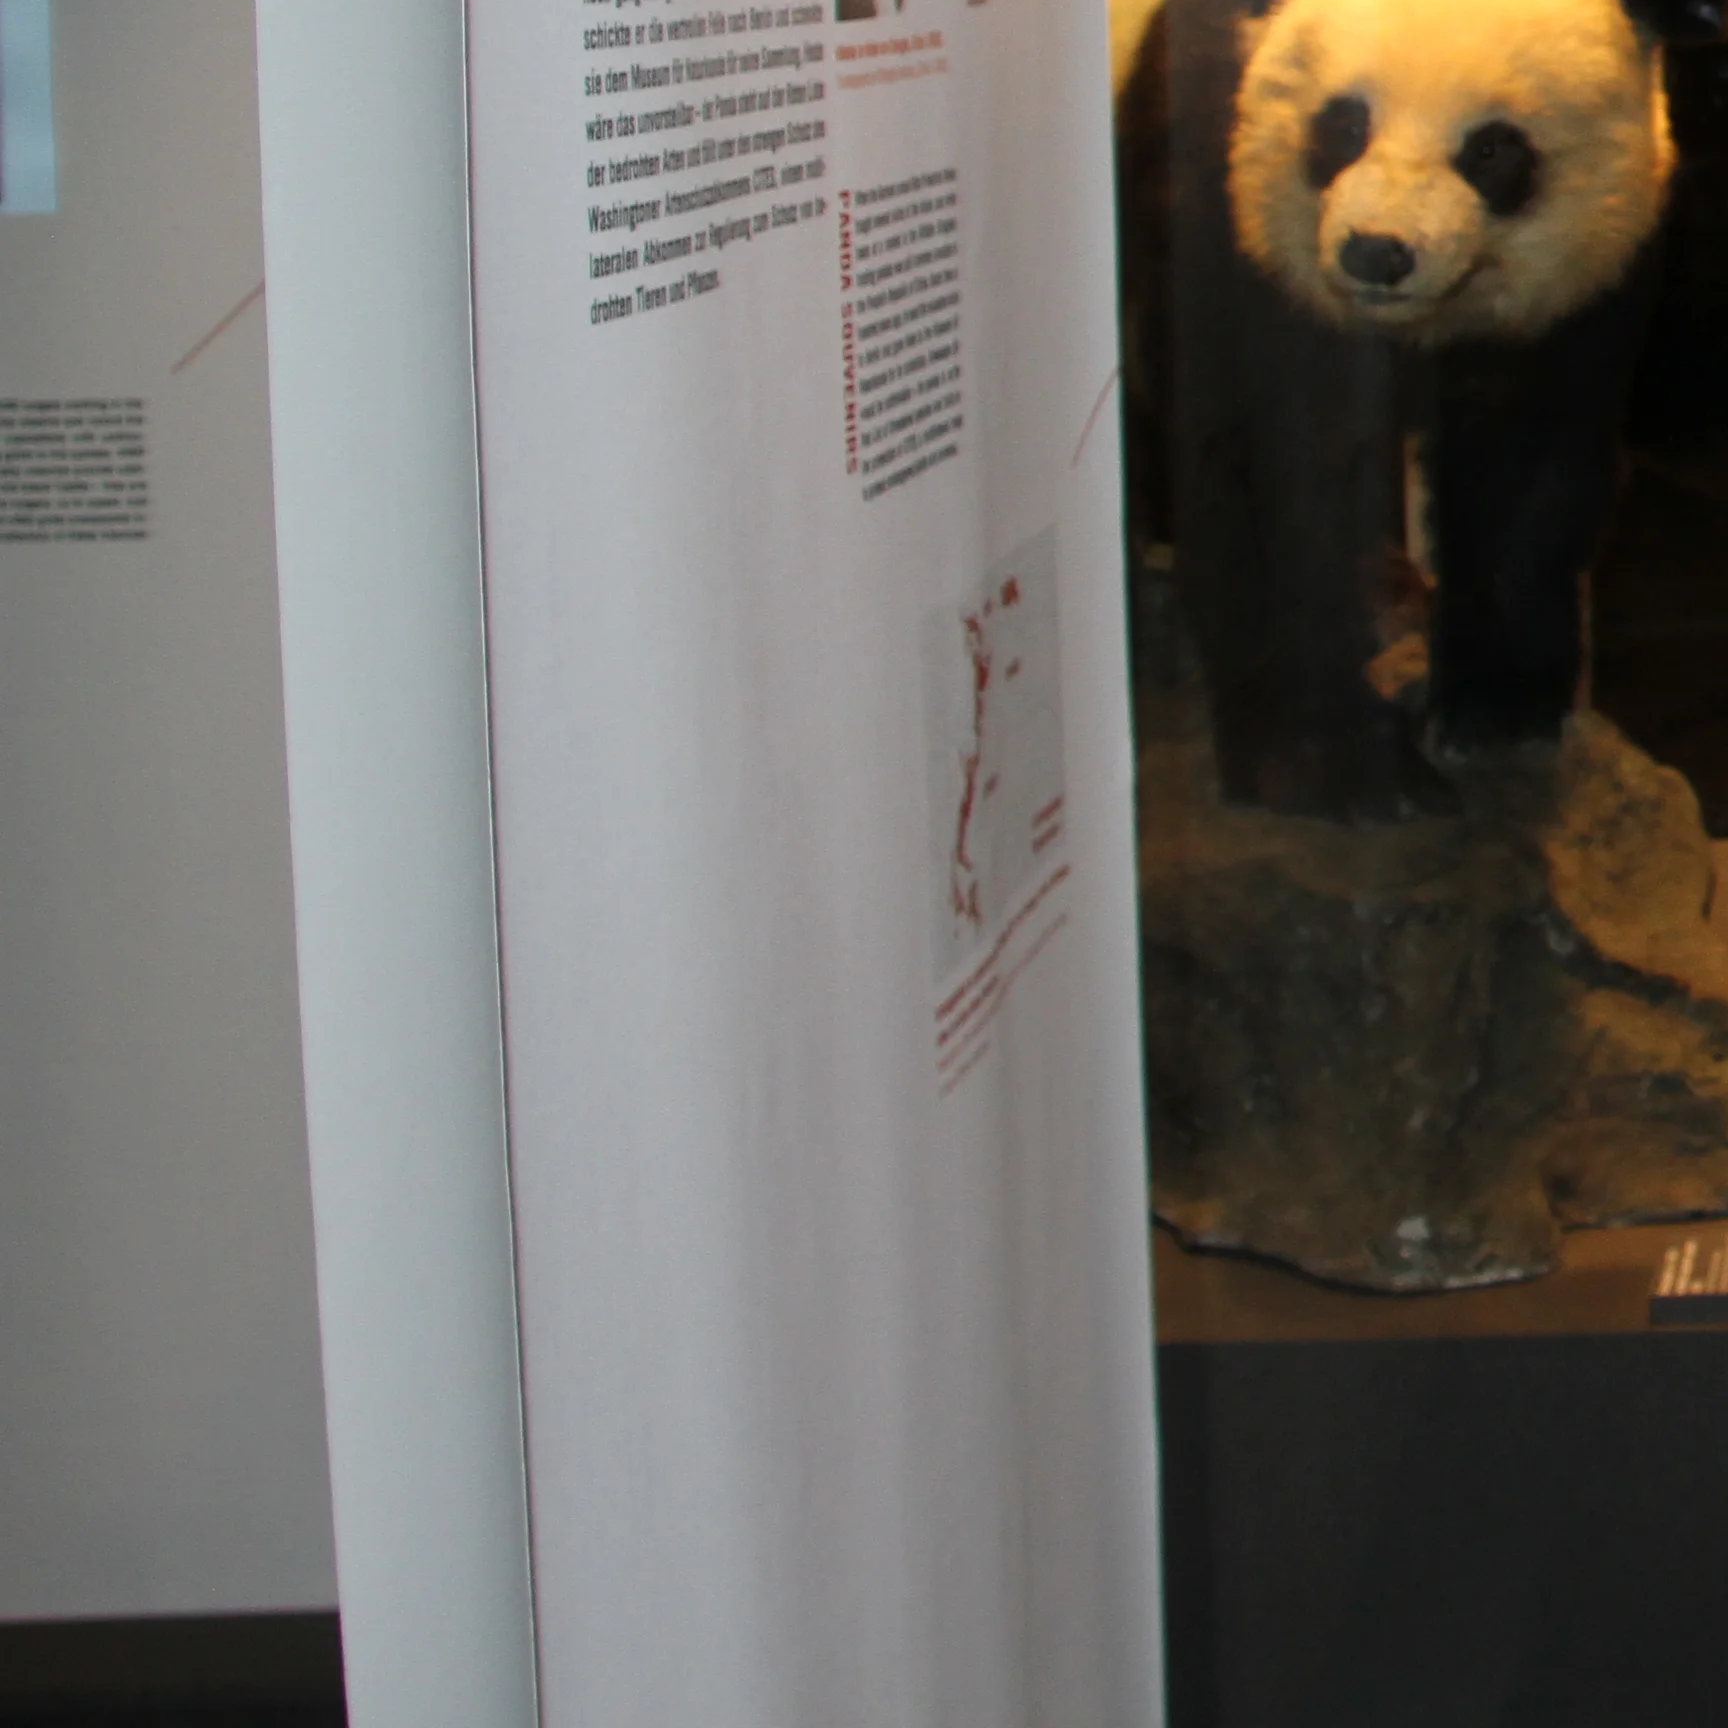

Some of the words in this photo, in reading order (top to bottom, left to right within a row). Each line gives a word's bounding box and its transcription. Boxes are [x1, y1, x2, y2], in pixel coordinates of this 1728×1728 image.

[583, 21, 631, 50] schickte
[635, 24, 646, 45] er
[585, 68, 602, 96] sie
[605, 68, 629, 94] dem
[630, 63, 670, 90] Museum
[586, 113, 614, 142] wäre
[616, 111, 636, 138] das
[587, 161, 606, 188] der
[608, 153, 661, 184] bedrohten
[587, 200, 662, 233] Washingtoner
[589, 246, 639, 281] lateralen
[643, 234, 693, 267] Abkommen
[590, 294, 633, 325] drohten
[635, 285, 667, 313] Tieren
